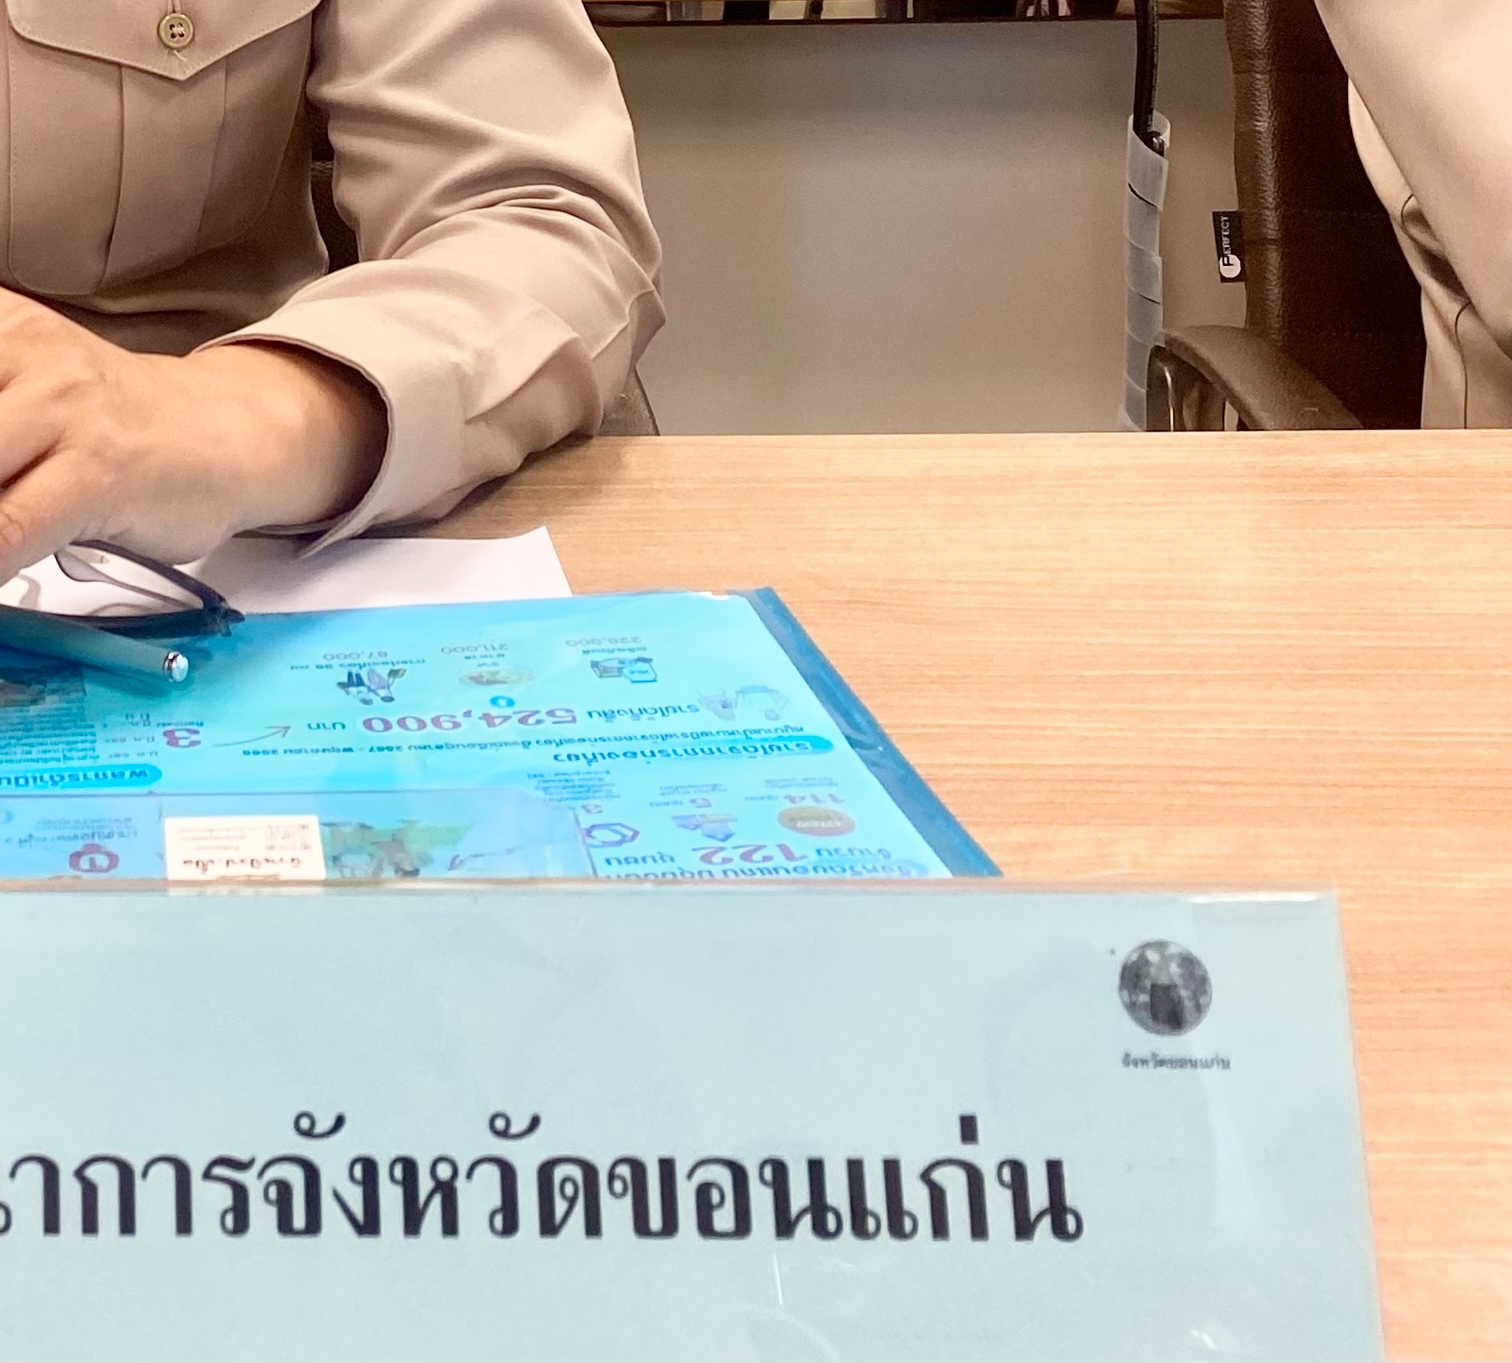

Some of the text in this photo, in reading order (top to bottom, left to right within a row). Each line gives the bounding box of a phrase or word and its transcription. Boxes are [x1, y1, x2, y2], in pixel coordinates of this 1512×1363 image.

[361, 708, 577, 733] 524,900
[162, 728, 201, 748] 3
[691, 843, 808, 866] 122
